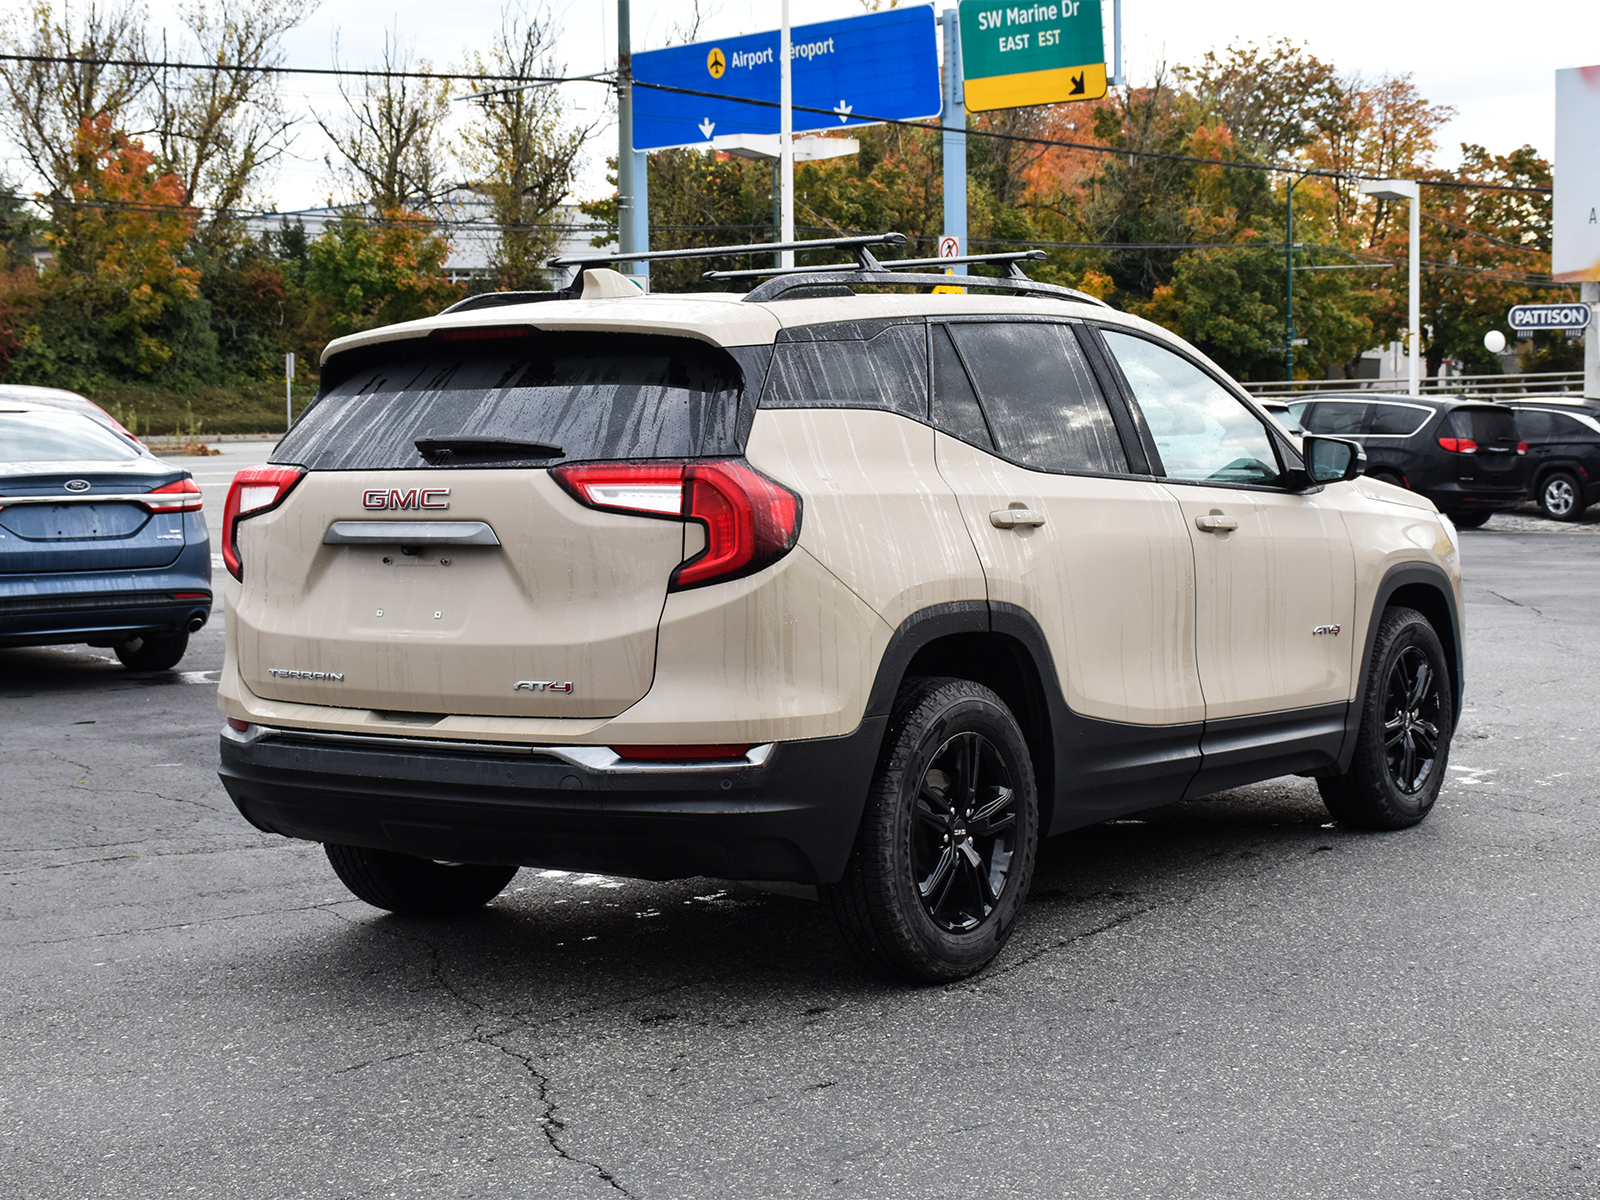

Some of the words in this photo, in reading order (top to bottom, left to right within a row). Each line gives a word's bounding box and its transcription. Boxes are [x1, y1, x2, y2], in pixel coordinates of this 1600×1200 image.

[978, 9, 1002, 30] SW
[1006, 4, 1058, 26] Marine
[1061, 0, 1080, 18] Dr
[999, 33, 1030, 52] EAST
[1038, 29, 1061, 47] EST
[731, 47, 773, 70] Airport
[1514, 309, 1584, 324] PATTISON
[362, 488, 451, 510] GMC
[1312, 623, 1341, 636] AT4
[268, 668, 344, 682] TERRAIN
[513, 680, 573, 696] AT4
